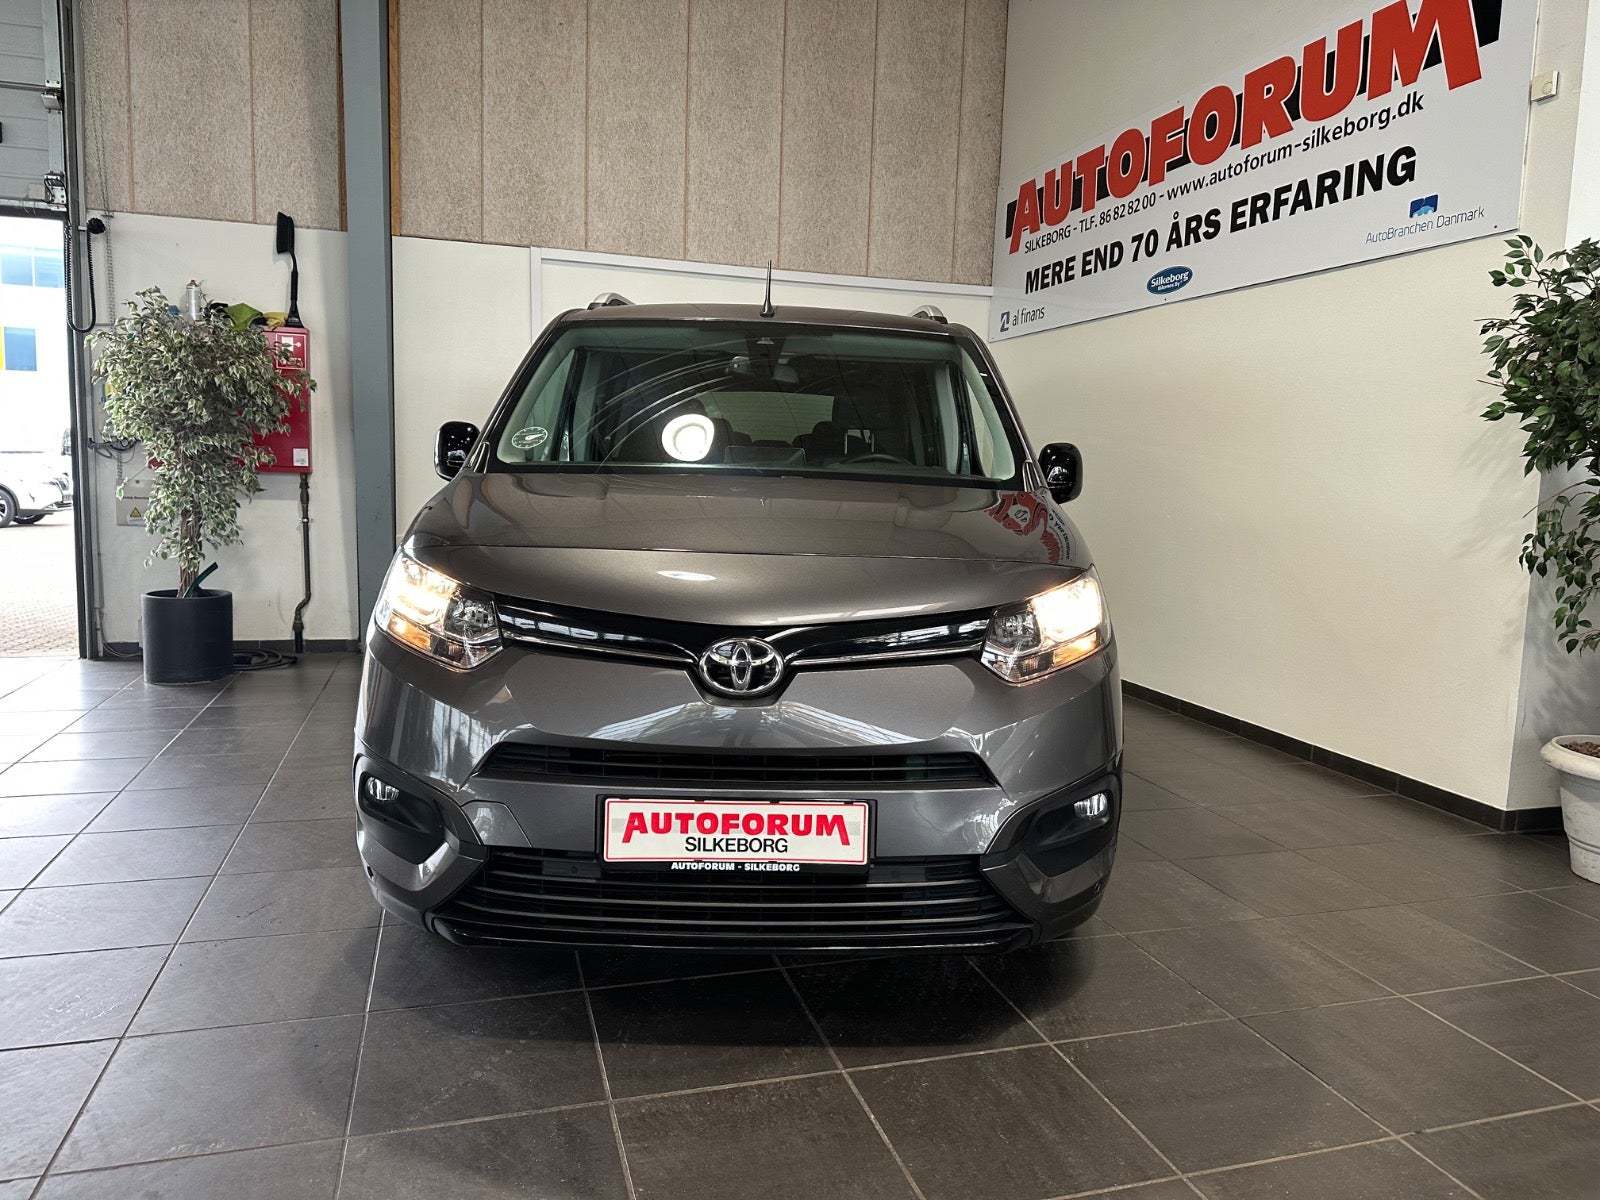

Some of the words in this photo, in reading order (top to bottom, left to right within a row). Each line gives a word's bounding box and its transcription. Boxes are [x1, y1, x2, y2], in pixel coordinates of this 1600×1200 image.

[1008, 0, 1483, 254] AUTOFORUM
[1024, 225, 1071, 254] SILKEBORG
[1079, 215, 1098, 233] TLF.
[1166, 91, 1424, 201] www.autoforum-silkeborg.dk
[1025, 255, 1077, 295] MERE
[1081, 240, 1124, 277] END
[1131, 228, 1159, 262] 70
[1165, 208, 1222, 252] ÅRS
[1229, 145, 1417, 233] ERFARING
[1365, 220, 1434, 244] AutoBranchen
[1436, 206, 1485, 228] Danmark
[1150, 271, 1190, 288] Silkeborg
[1012, 309, 1020, 326] al
[1020, 306, 1045, 325] finans
[621, 811, 851, 846] AUTOFORUM
[684, 836, 789, 854] SILKEBORG
[670, 861, 735, 871] AUTOFORUM
[744, 862, 801, 872] SILKEBORG
